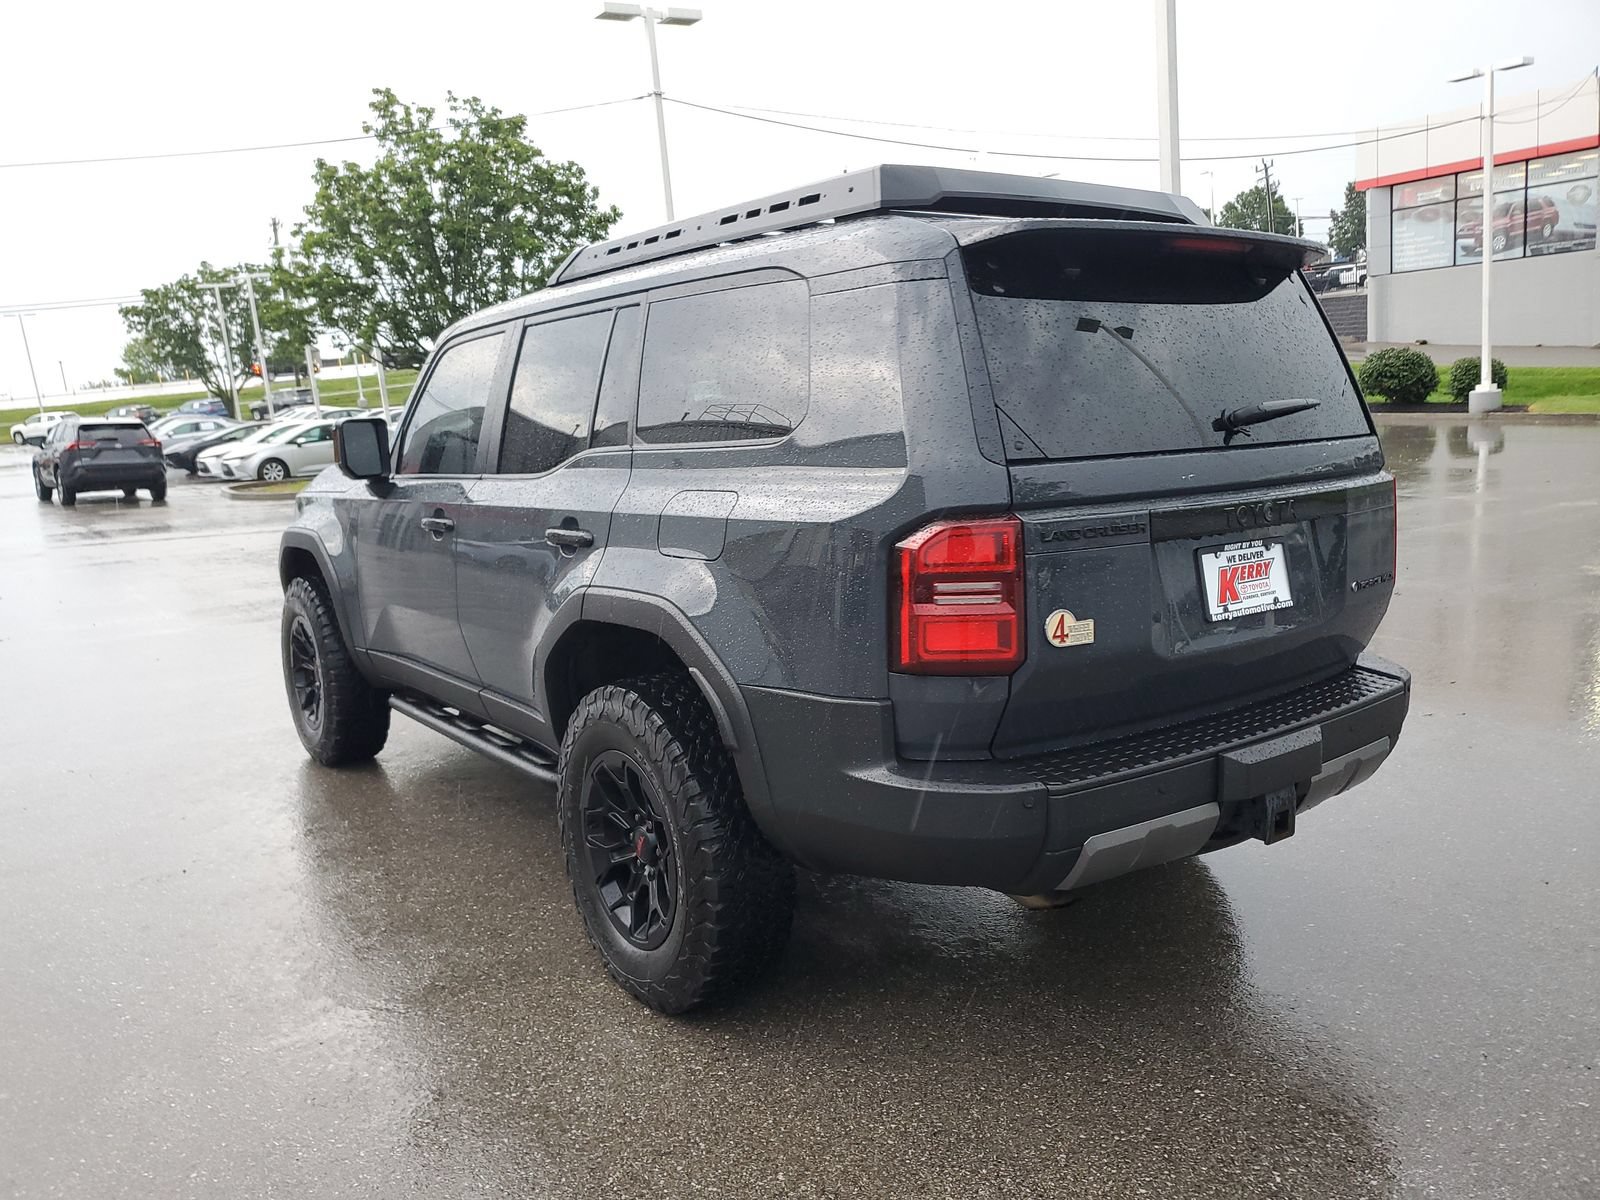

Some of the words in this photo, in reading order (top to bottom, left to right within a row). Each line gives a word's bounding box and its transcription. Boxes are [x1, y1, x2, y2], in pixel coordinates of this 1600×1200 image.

[1224, 500, 1296, 527] TOYOTA
[1224, 542, 1241, 551] RIGHT
[1242, 541, 1250, 549] BY
[1251, 540, 1263, 548] YOU
[1226, 555, 1237, 564] WE
[1238, 551, 1265, 562] DELIVER
[1218, 559, 1274, 606] KERRY
[1248, 581, 1270, 591] TOYOTA
[1212, 600, 1294, 622] kerryautomotive.com
[1052, 613, 1069, 644] 4
